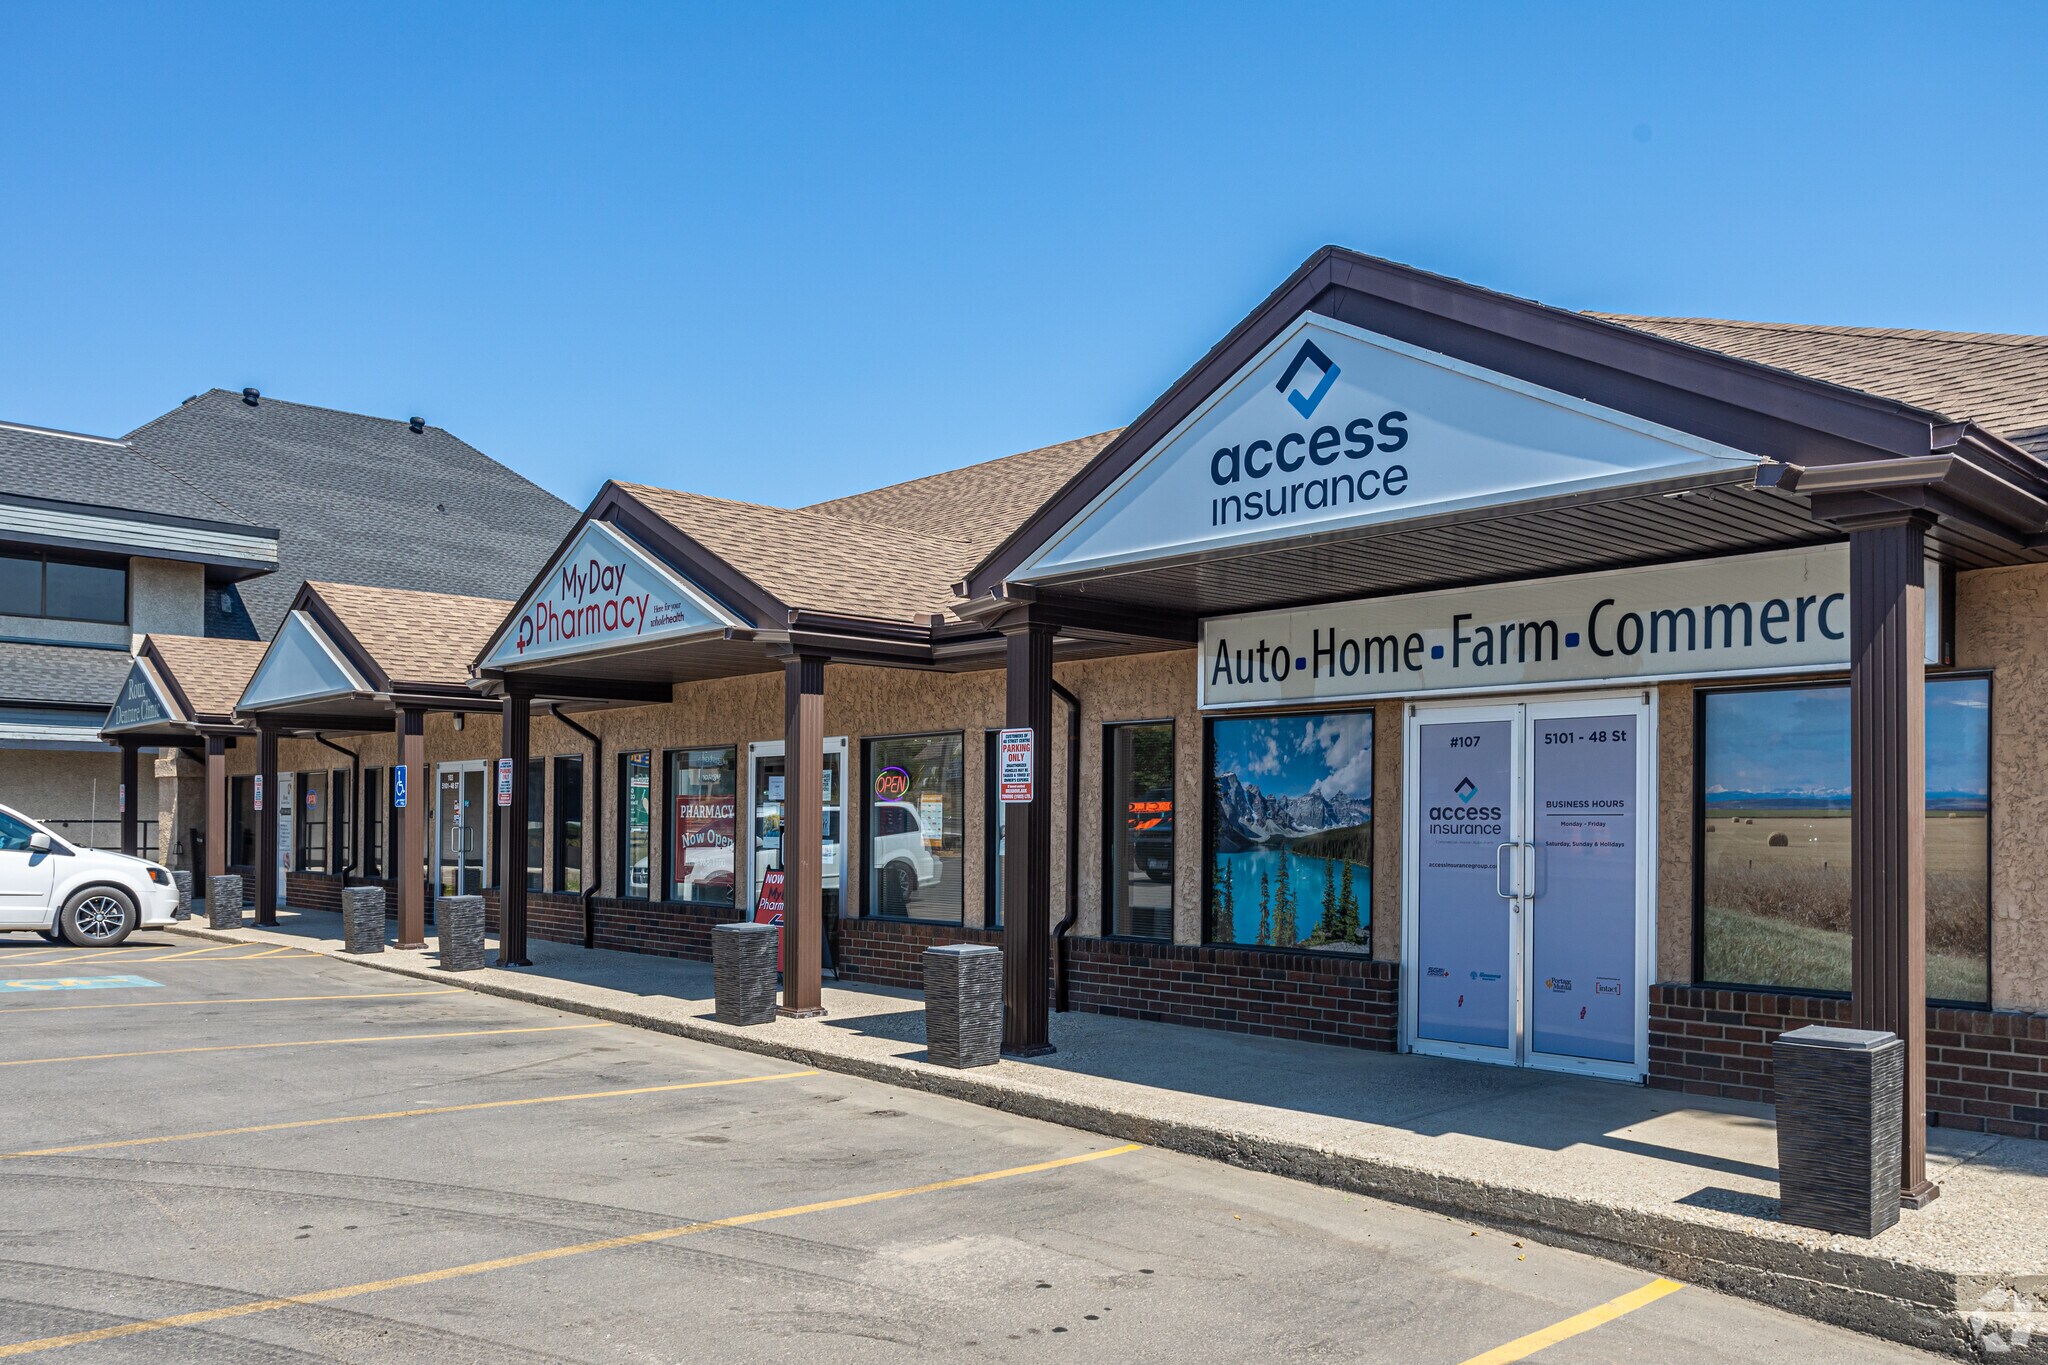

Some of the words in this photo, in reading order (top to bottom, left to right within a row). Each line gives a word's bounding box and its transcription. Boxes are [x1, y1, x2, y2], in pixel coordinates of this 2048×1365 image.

[1211, 410, 1409, 486] access
[1211, 464, 1409, 527] insurance
[653, 605, 664, 613] Here
[671, 602, 682, 612] your
[536, 594, 649, 645] Pharmacy
[1212, 638, 1291, 687] Auto
[1312, 627, 1426, 679] Home
[1452, 613, 1559, 669] Farm
[1588, 592, 1845, 658] Commerc
[128, 679, 146, 700] Roux
[116, 706, 140, 724] Denture
[141, 698, 160, 720] Clinic
[1450, 736, 1481, 748] #107
[1544, 732, 1574, 744] 5101
[1588, 731, 1607, 743] 48
[1612, 730, 1627, 742] St
[1002, 744, 1030, 752] PARKING
[1008, 754, 1024, 762] ONLY
[876, 775, 906, 793] OPEN
[680, 804, 734, 818] PHARMACY
[1546, 800, 1589, 808] BUSINESS
[1592, 800, 1624, 808] HOURS
[1429, 807, 1502, 820] access
[1429, 824, 1502, 835] insurance
[682, 833, 704, 848] Now
[707, 829, 734, 847] Open
[765, 874, 784, 884] NOW
[759, 898, 784, 910] Pharm
